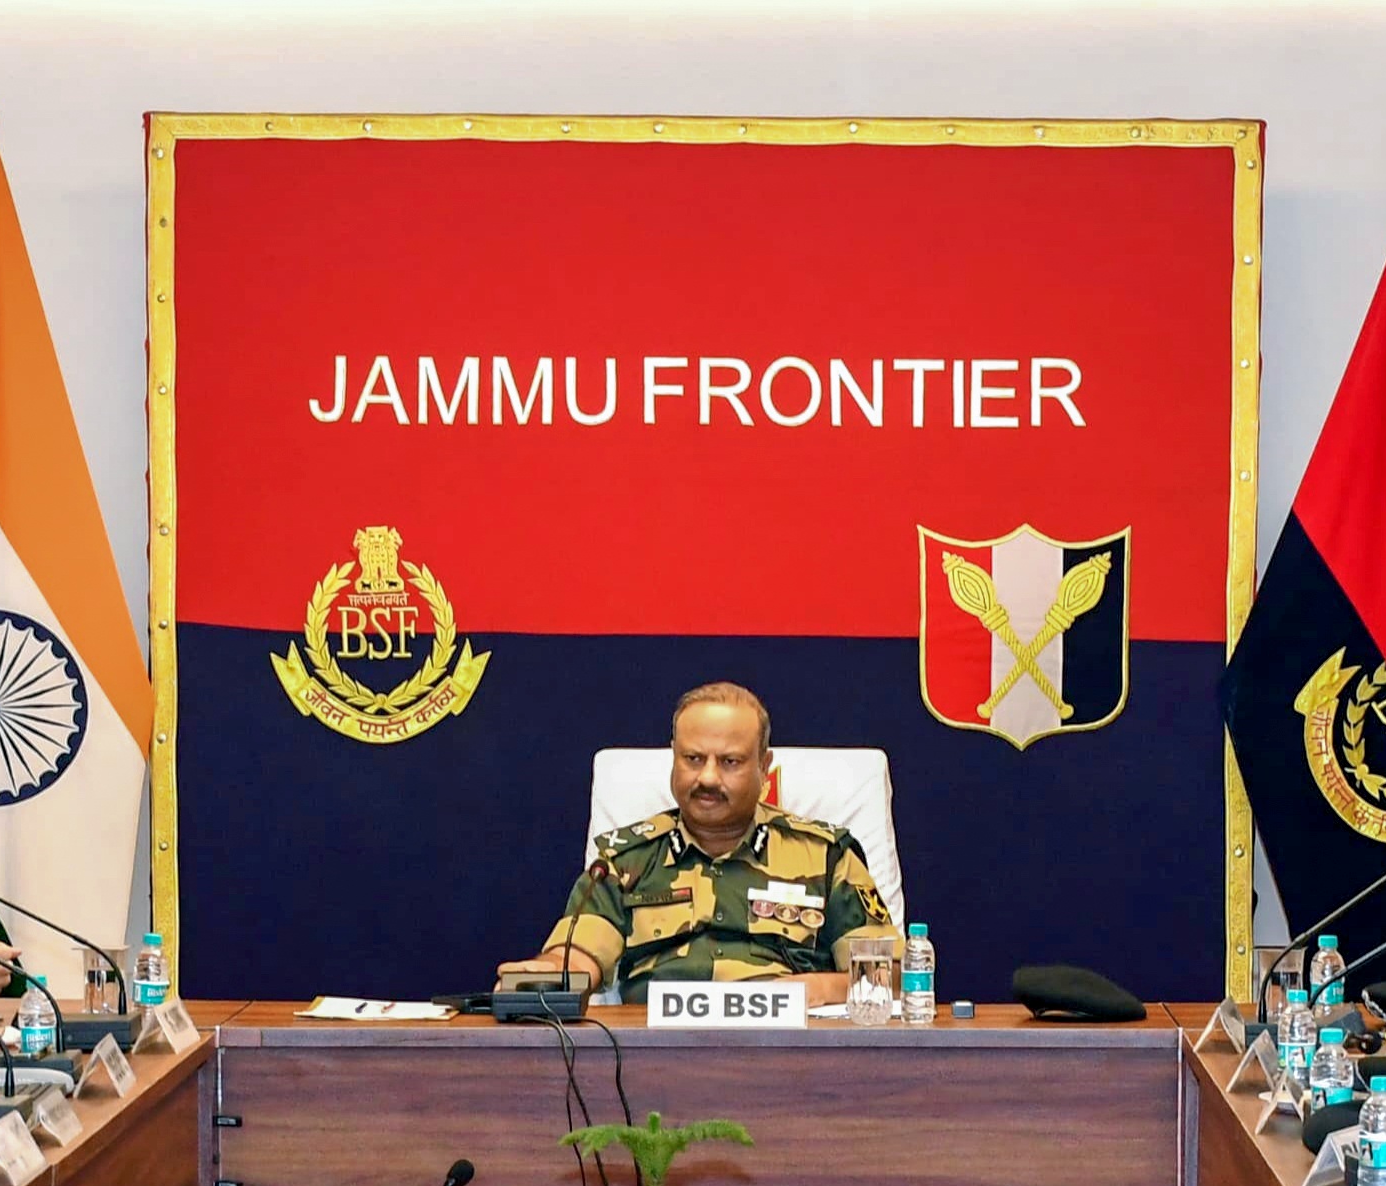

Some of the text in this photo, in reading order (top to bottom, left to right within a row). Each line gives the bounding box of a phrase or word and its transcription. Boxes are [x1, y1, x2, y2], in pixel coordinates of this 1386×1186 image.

[309, 355, 1086, 428] JAMMU FRONTIER
[337, 606, 419, 660] BSF
[662, 992, 790, 1018] DG BSF
